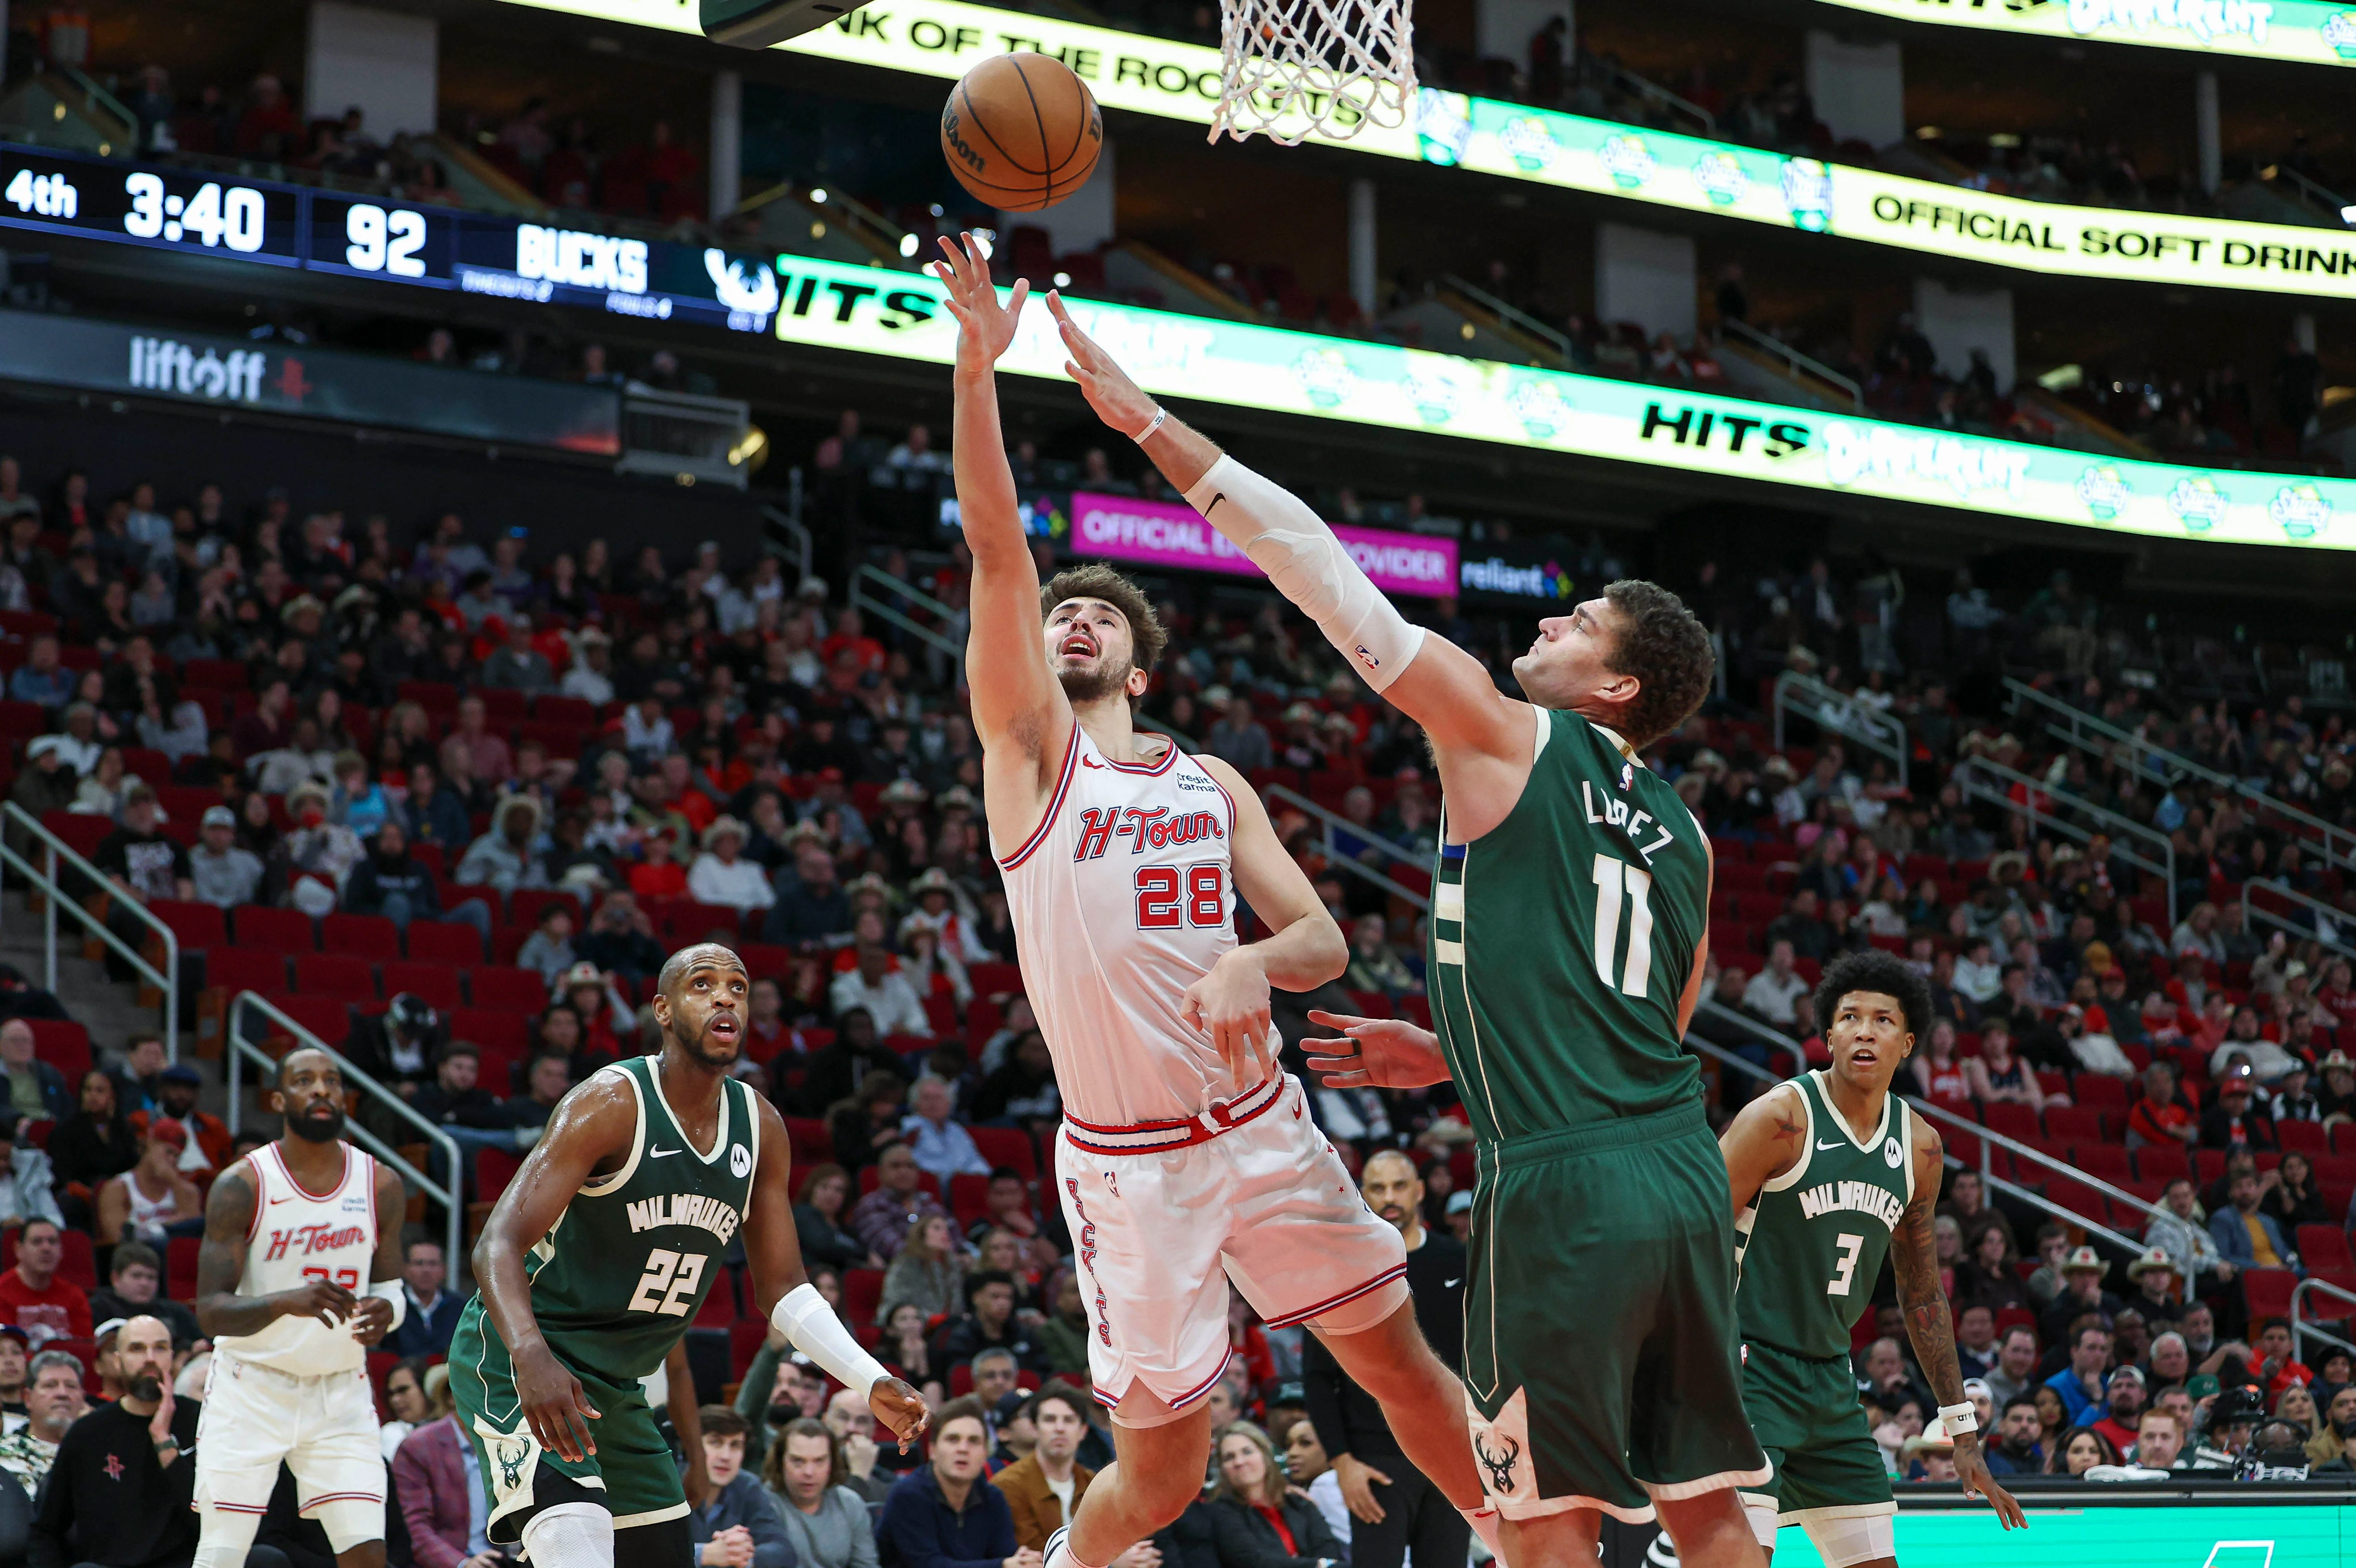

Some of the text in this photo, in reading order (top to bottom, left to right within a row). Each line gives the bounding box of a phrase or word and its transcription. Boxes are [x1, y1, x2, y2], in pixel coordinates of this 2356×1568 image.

[911, 21, 981, 53] OF
[6, 169, 77, 219] 4th
[124, 172, 265, 253] 3:40
[346, 203, 426, 278] 92
[1873, 194, 2065, 252] OFFICIAL
[2080, 228, 2210, 263] SOFT
[517, 223, 648, 294] BUCKS
[778, 276, 936, 329] ITS
[129, 335, 266, 402] liftoff
[1641, 404, 1810, 458] HITS
[1460, 556, 1545, 598] reliant
[1177, 772, 1211, 785] credit
[1178, 779, 1216, 792] karma
[1074, 805, 1225, 863] H-Town
[1133, 863, 1226, 930] 28
[1592, 852, 1653, 998] 11
[626, 1193, 740, 1246] MILWAUKEE
[1798, 1180, 1905, 1233] MILWAUKEE
[263, 1220, 366, 1261] H-Town
[1827, 1233, 1864, 1296] 3
[627, 1248, 709, 1318] 22
